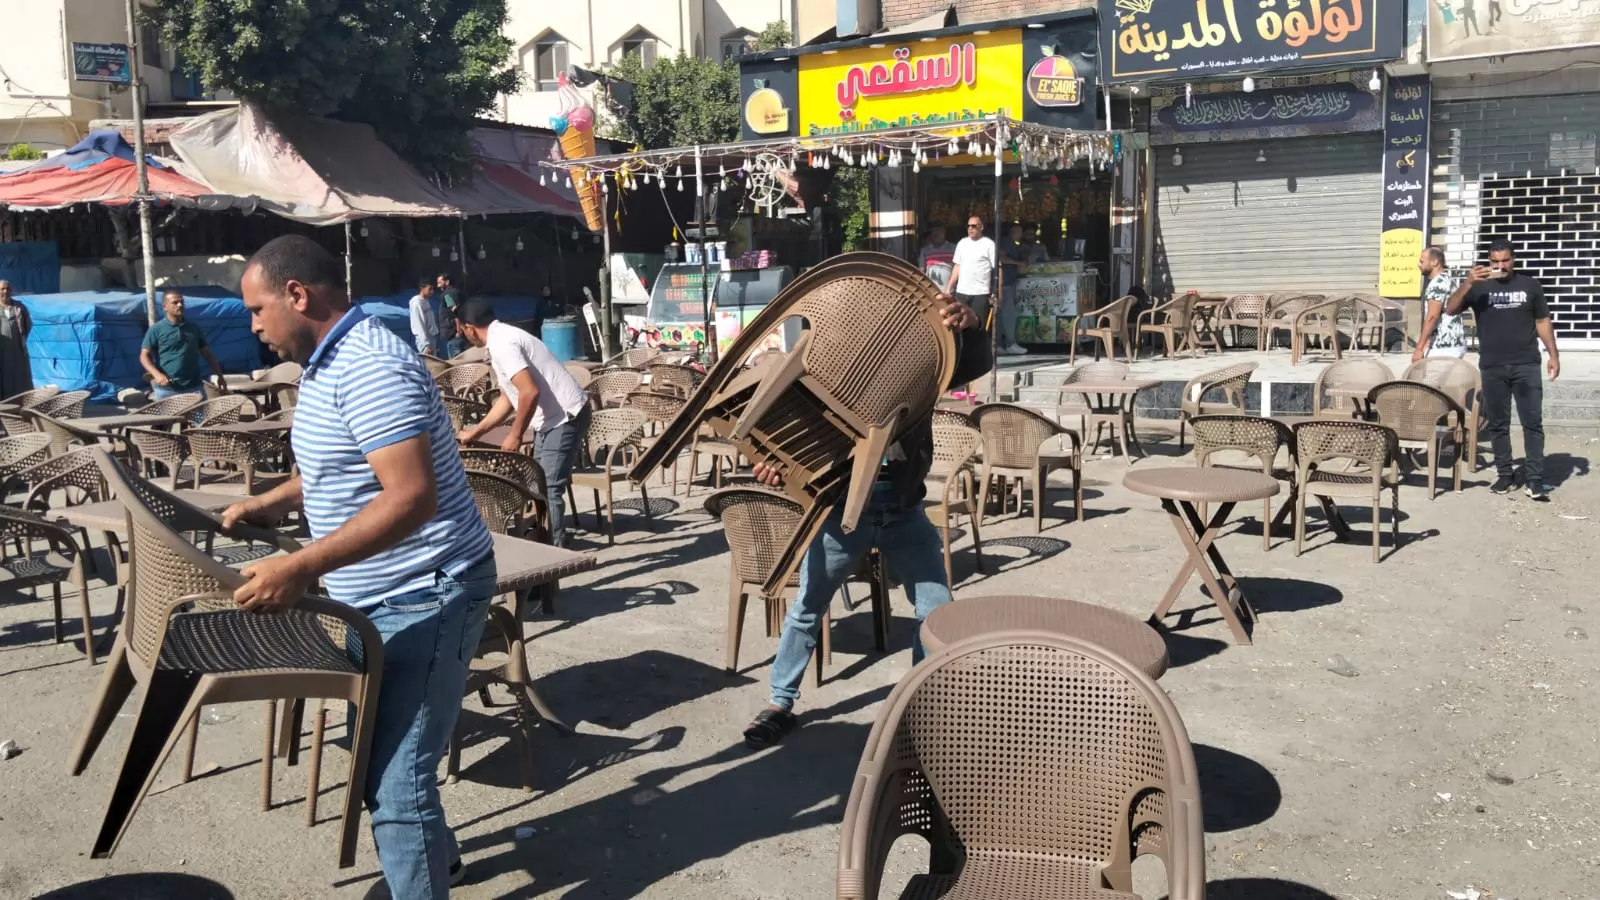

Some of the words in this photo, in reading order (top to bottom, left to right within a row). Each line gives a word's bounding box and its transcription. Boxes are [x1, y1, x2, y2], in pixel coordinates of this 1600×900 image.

[1119, 0, 1242, 61] المدينة
[836, 41, 976, 121] السقعي
[1390, 108, 1424, 123] المدينة
[1391, 134, 1422, 146] ترحب
[1396, 149, 1416, 168] بكم
[1394, 195, 1413, 207] البيت
